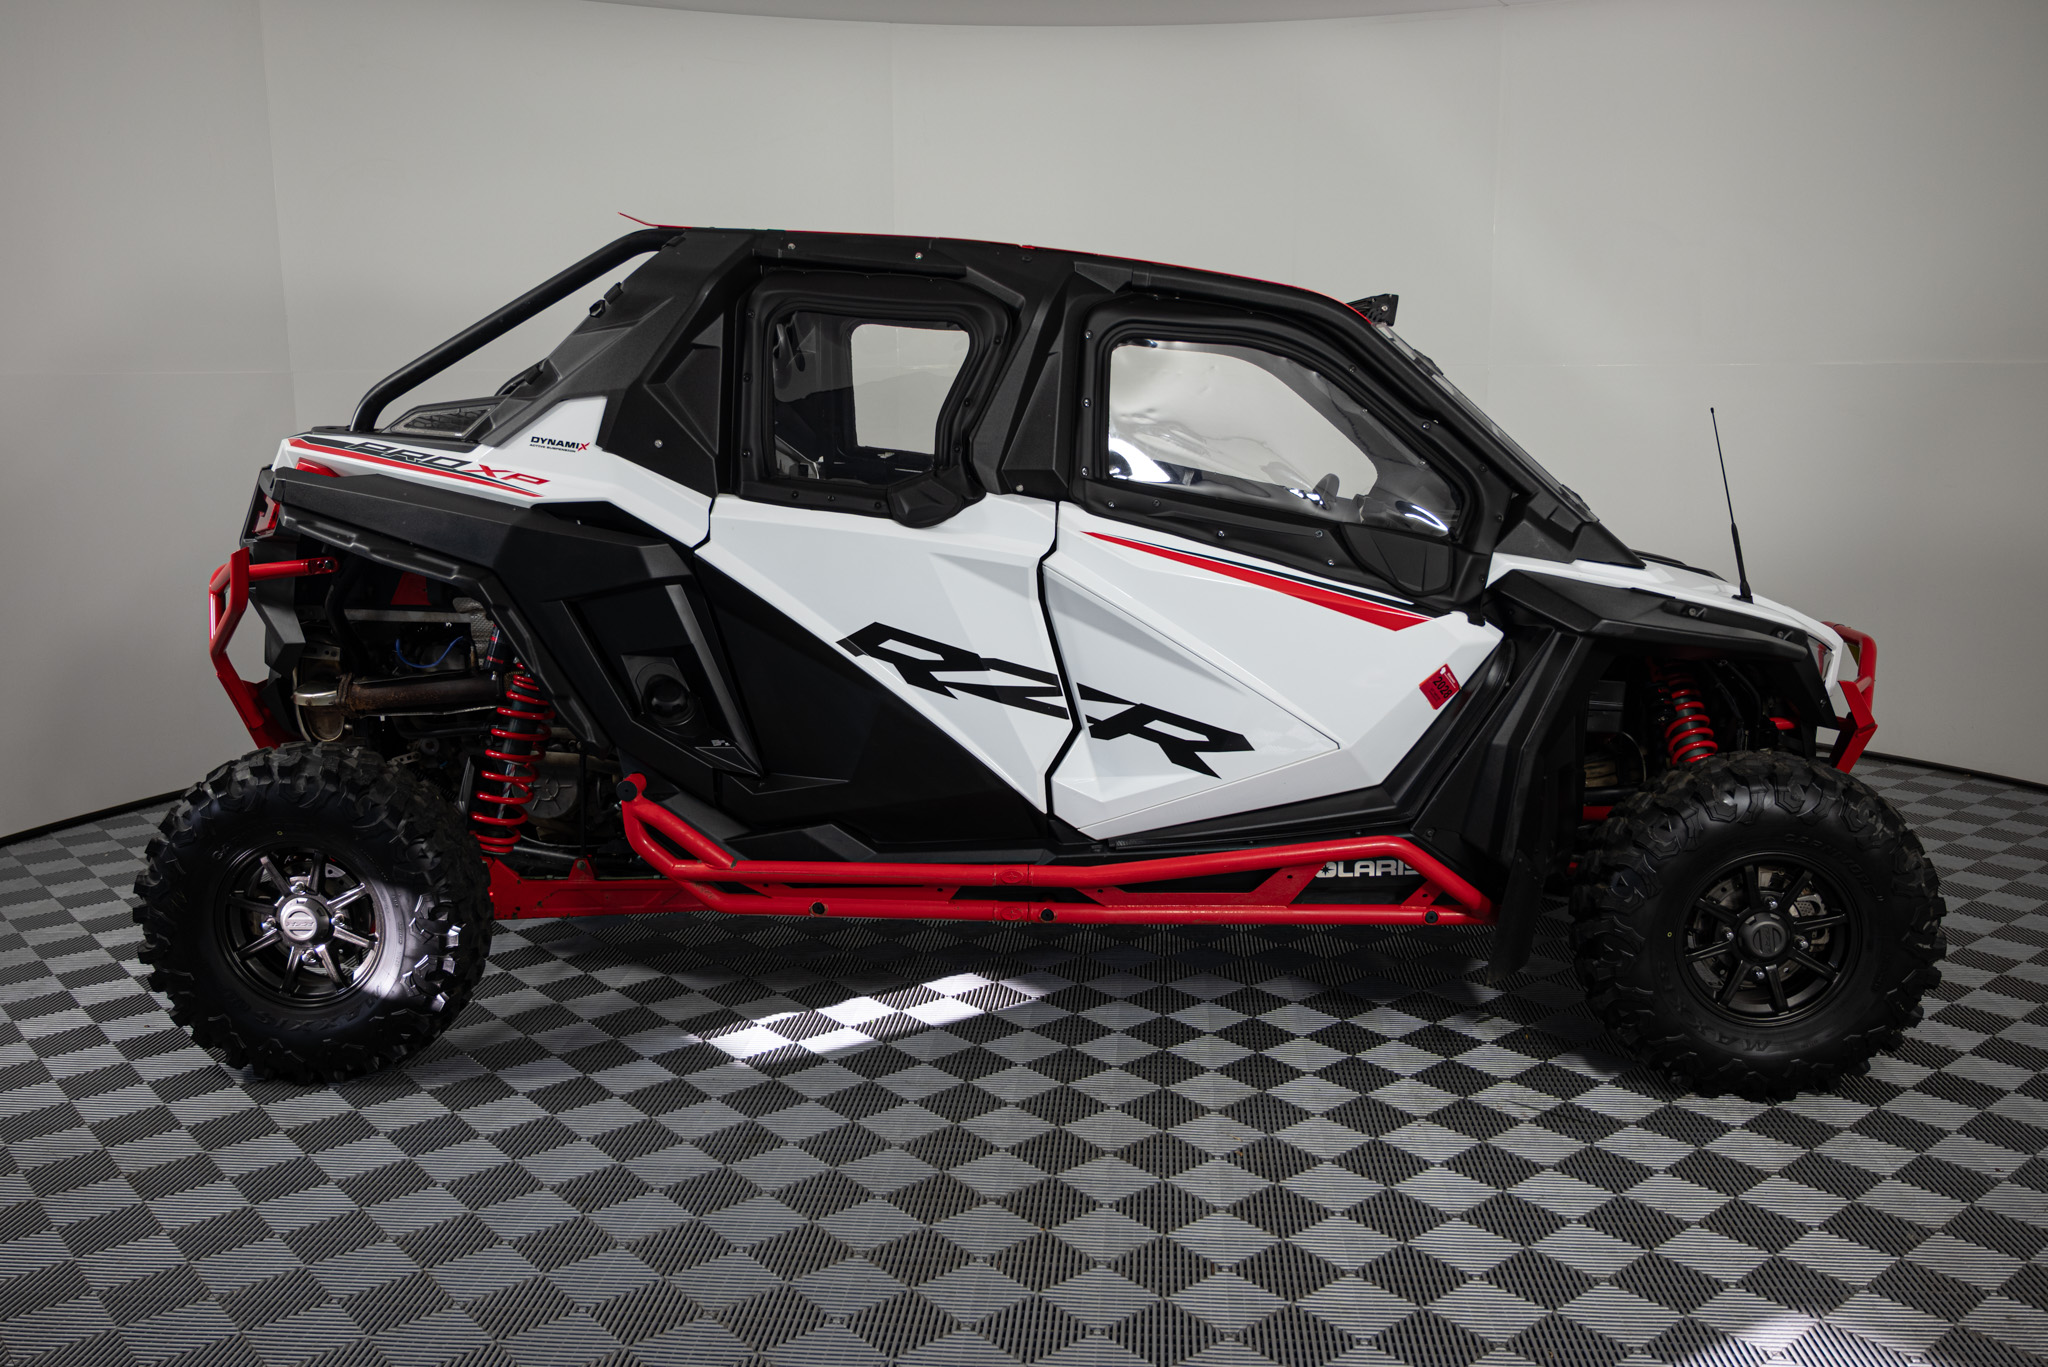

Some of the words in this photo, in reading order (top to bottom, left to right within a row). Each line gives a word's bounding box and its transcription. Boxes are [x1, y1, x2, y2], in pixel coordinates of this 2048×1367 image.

[530, 435, 591, 452] DYNAMIX
[346, 441, 473, 470] PRO
[461, 463, 551, 486] XP
[1433, 676, 1453, 699] 2028
[835, 621, 1256, 780] RZR
[1315, 859, 1420, 878] OLARI
